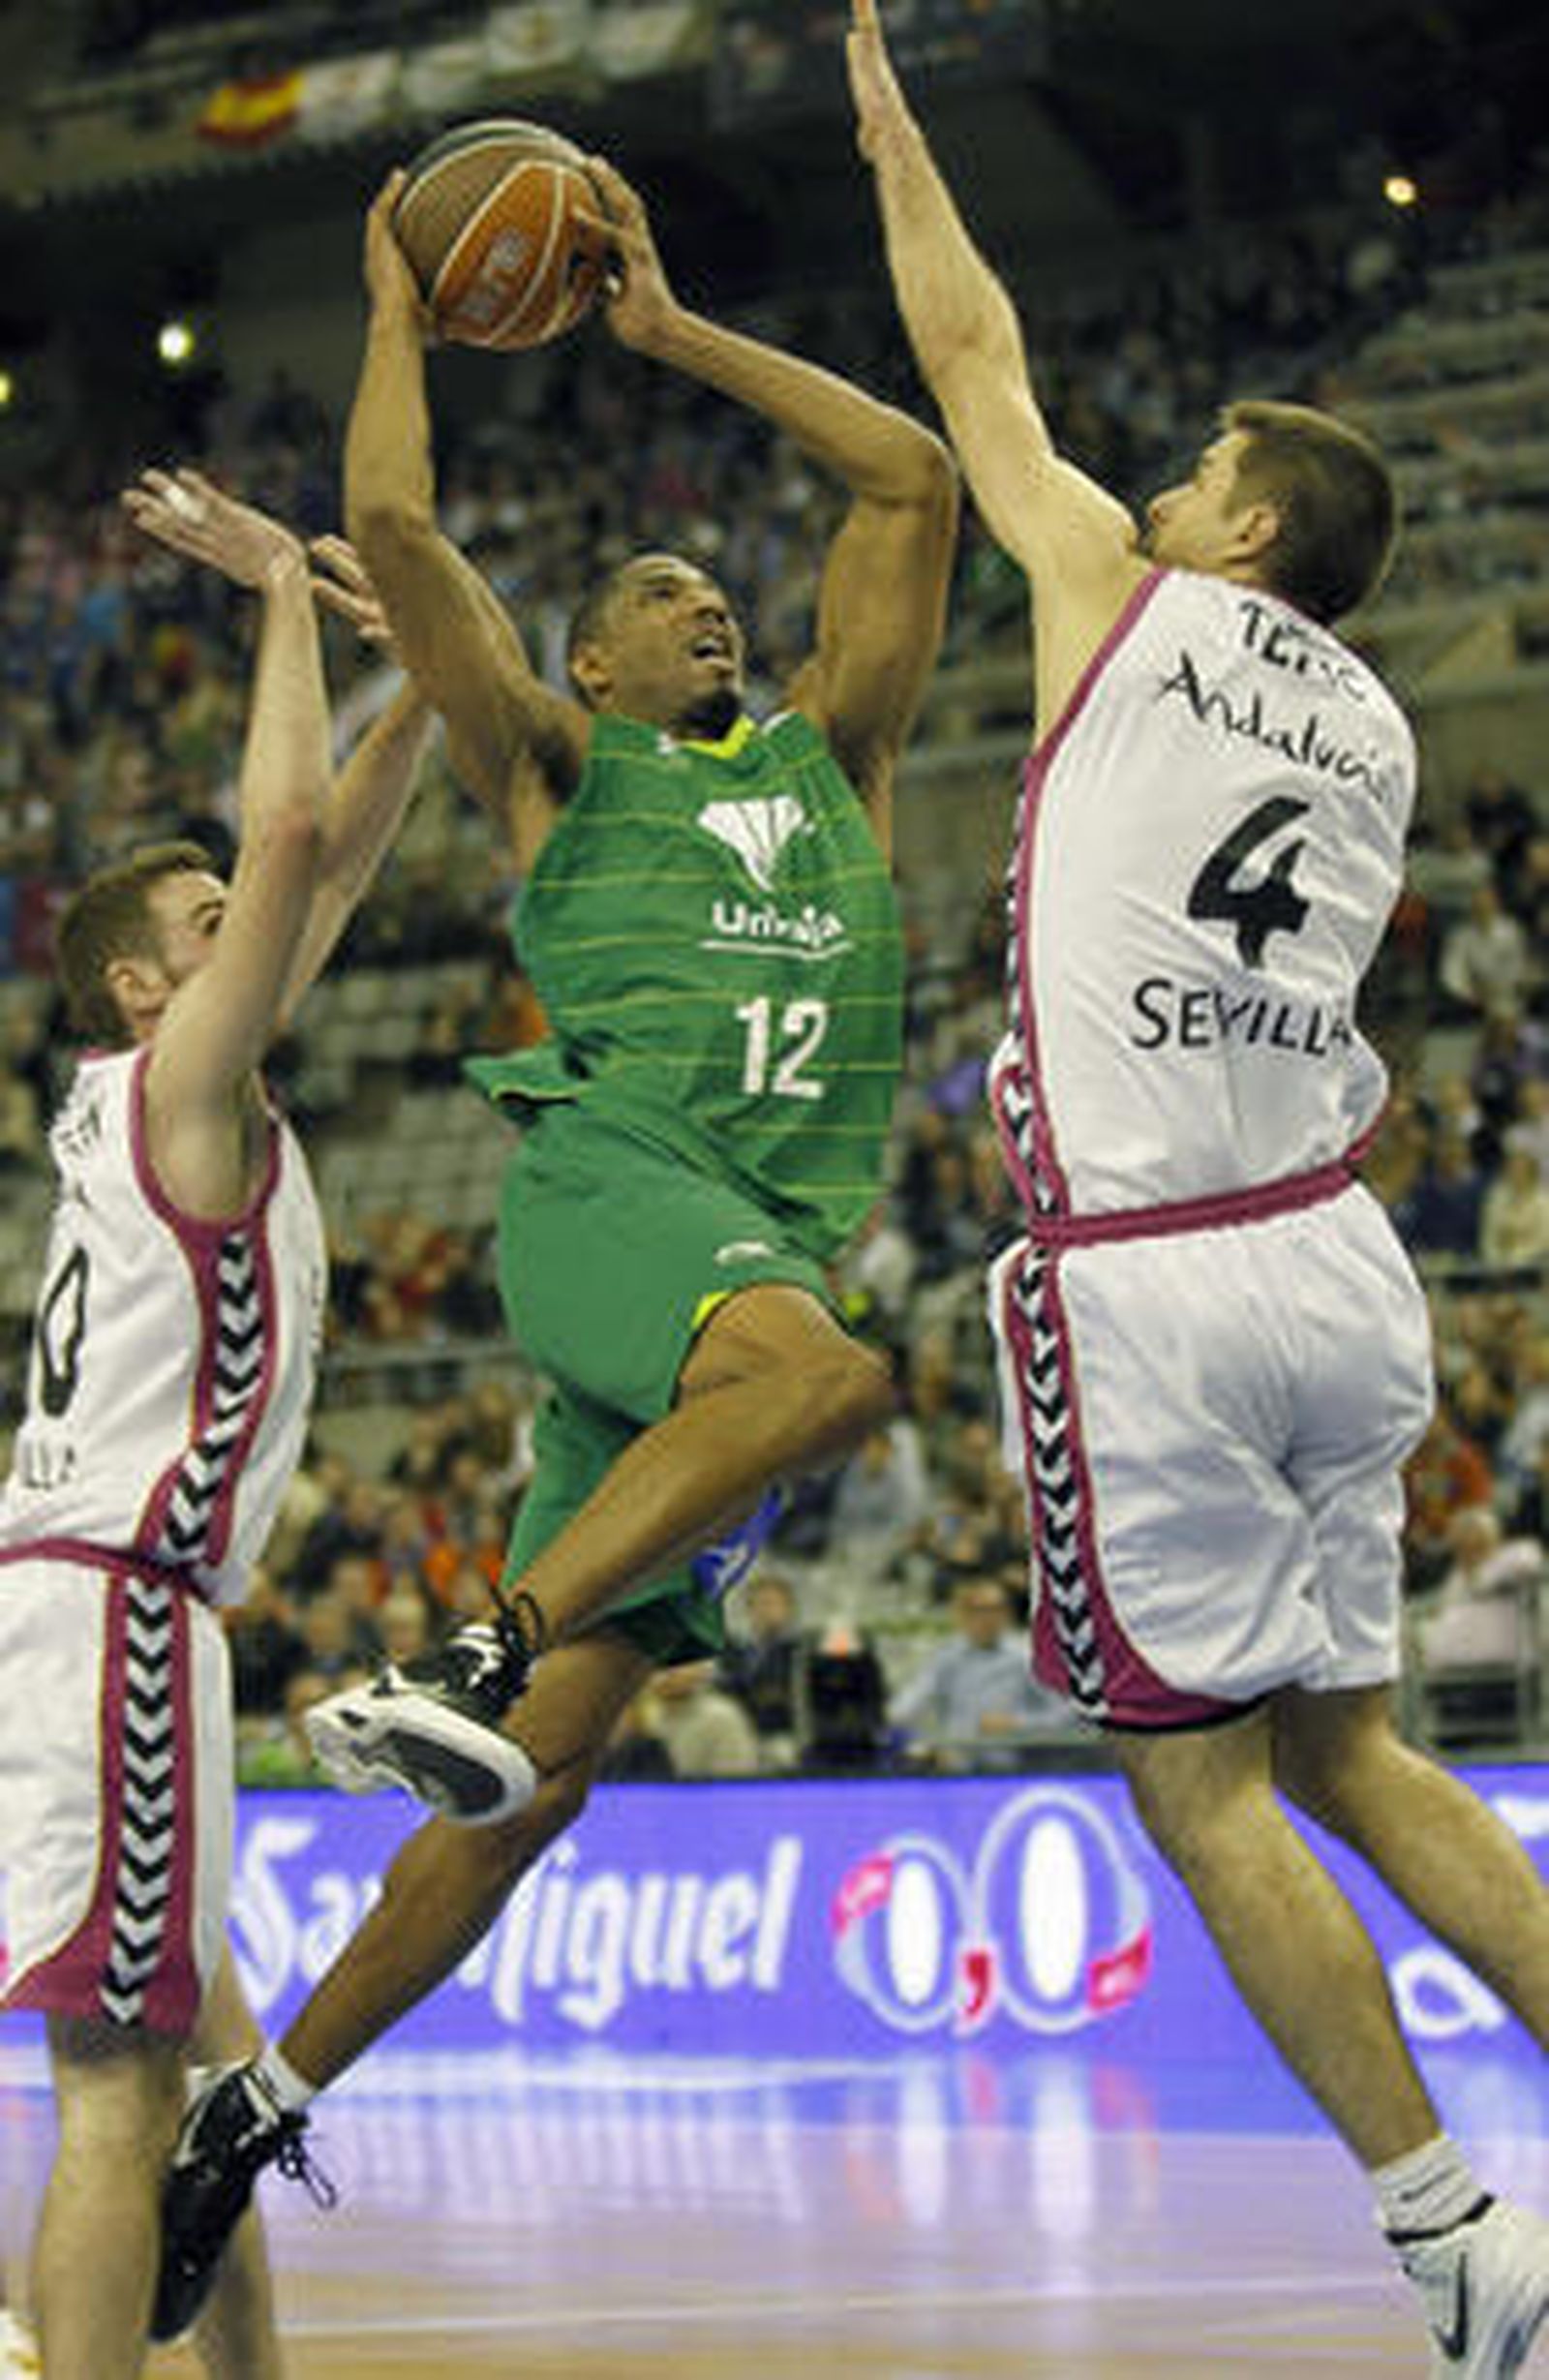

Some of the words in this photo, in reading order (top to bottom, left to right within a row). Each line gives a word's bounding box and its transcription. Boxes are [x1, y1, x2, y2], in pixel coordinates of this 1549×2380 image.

[1187, 796, 1310, 968] 4
[735, 995, 828, 1100] 12
[225, 1816, 384, 2012] Sa
